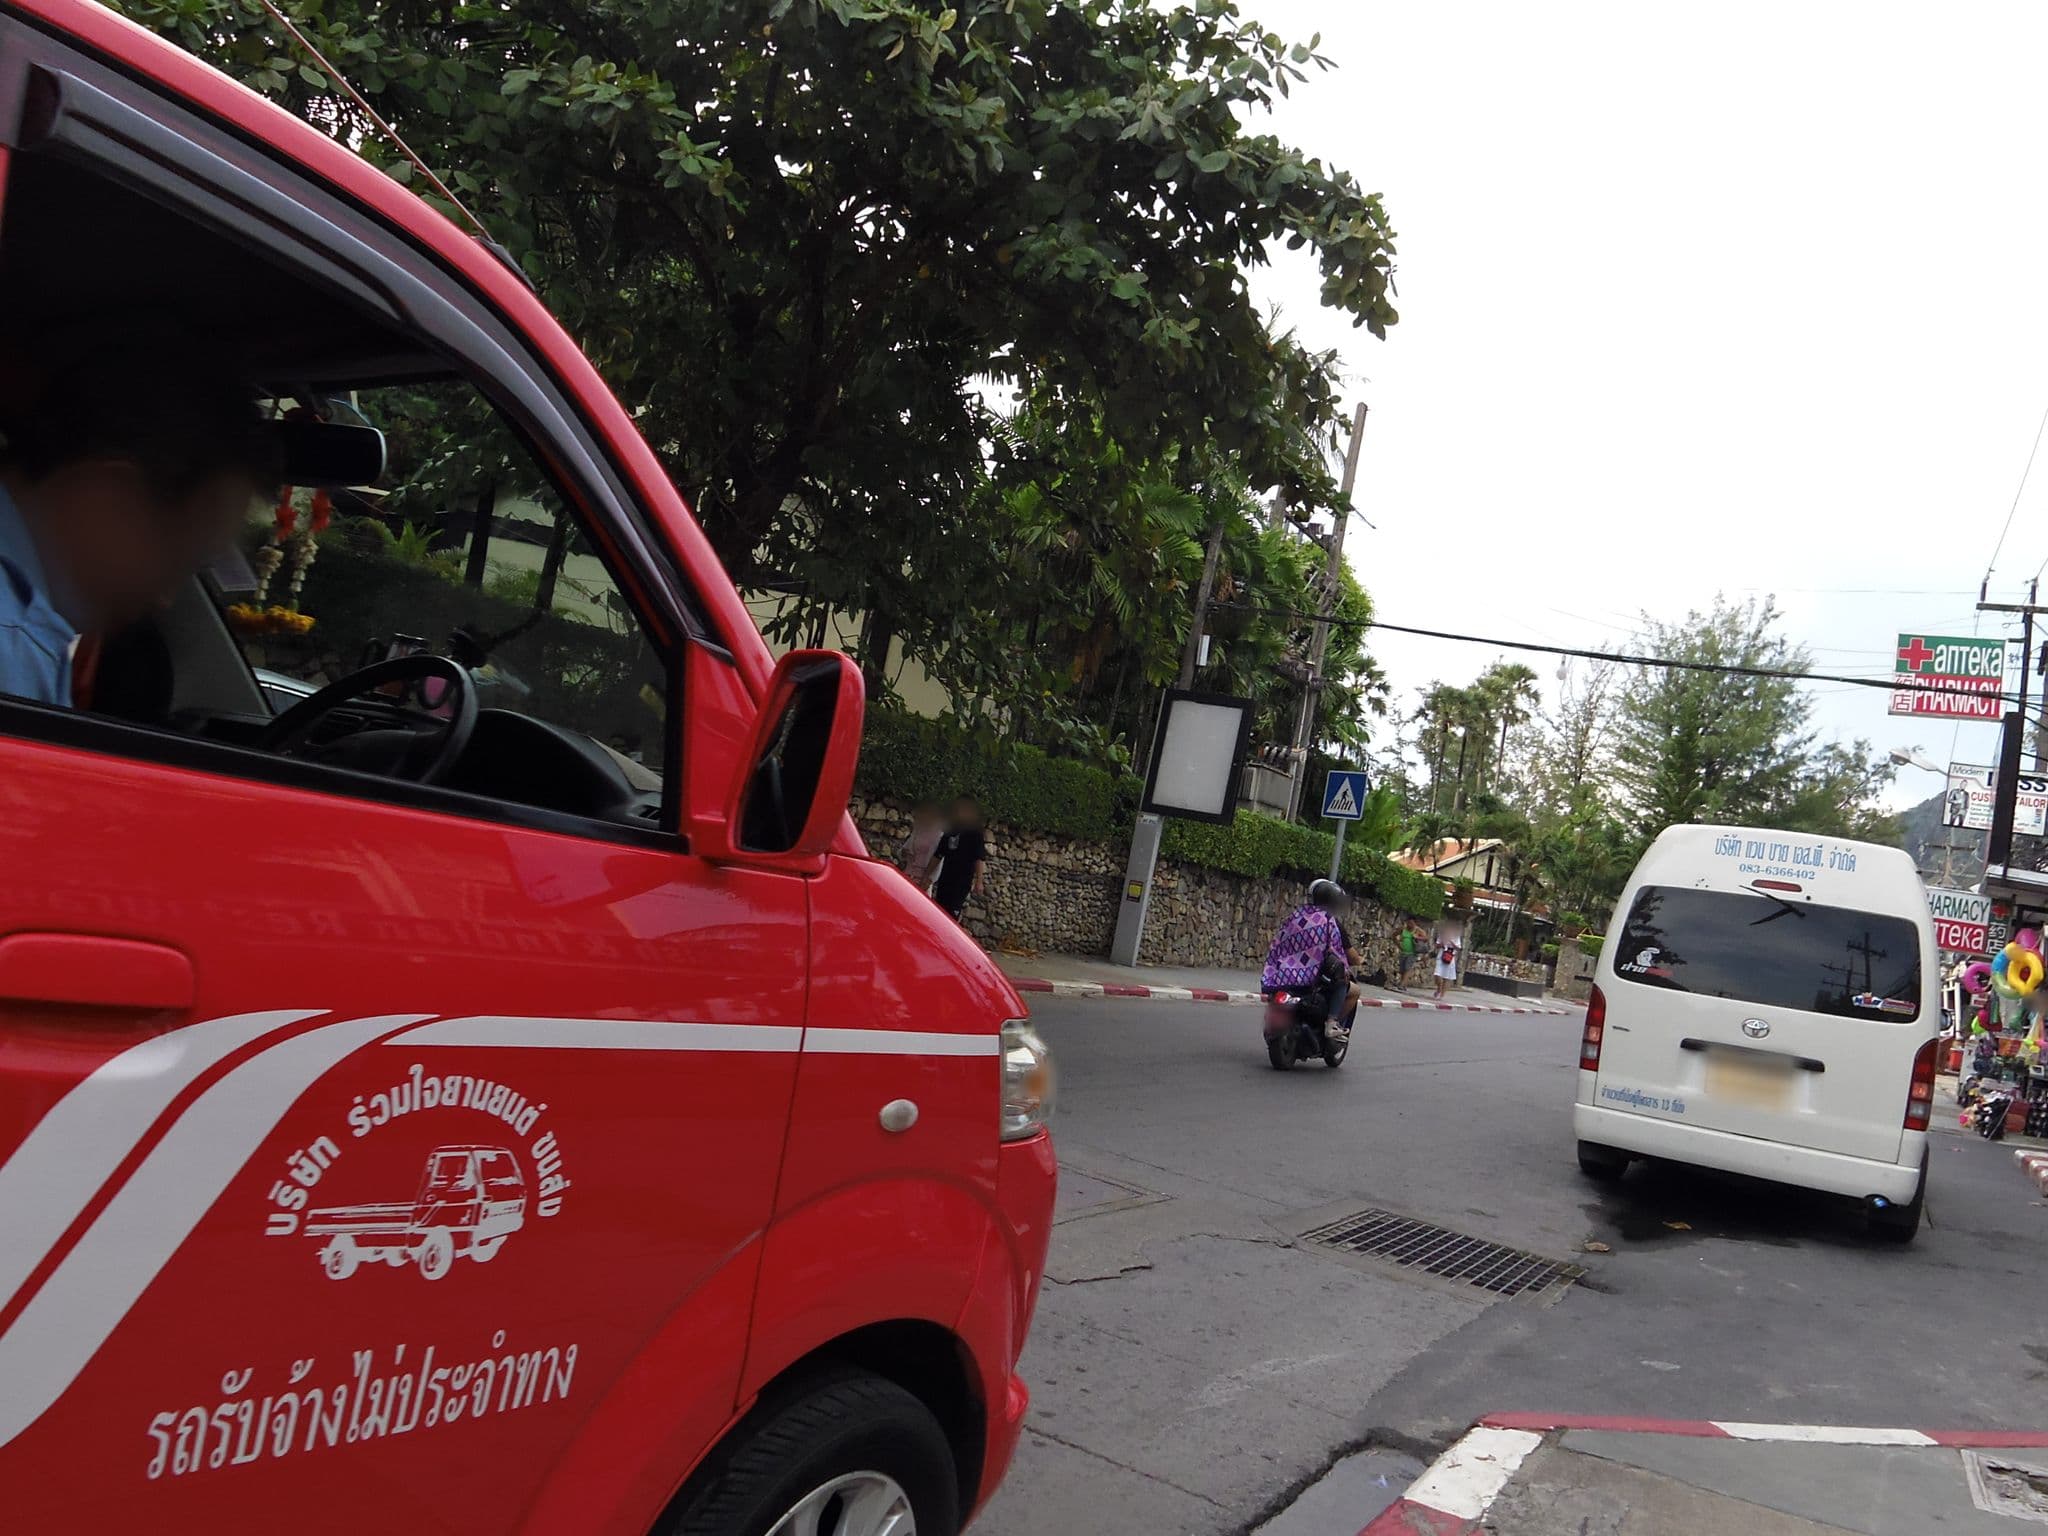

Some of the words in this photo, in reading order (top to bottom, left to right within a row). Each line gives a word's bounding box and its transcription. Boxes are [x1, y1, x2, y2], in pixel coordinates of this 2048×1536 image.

[1934, 644, 2002, 676] аптека
[1912, 677, 2001, 716] PHARMACY
[1715, 834, 1743, 858] บริษัท
[1927, 893, 1990, 922] HARMACY
[1934, 921, 1985, 951] тека
[264, 1134, 342, 1236] บริษัท
[347, 1063, 550, 1138] ร่วมใจยานยนต์
[531, 1131, 572, 1217] ขนส่ง
[146, 1329, 578, 1480] รถรับจ้างไม่ประจำทาง
